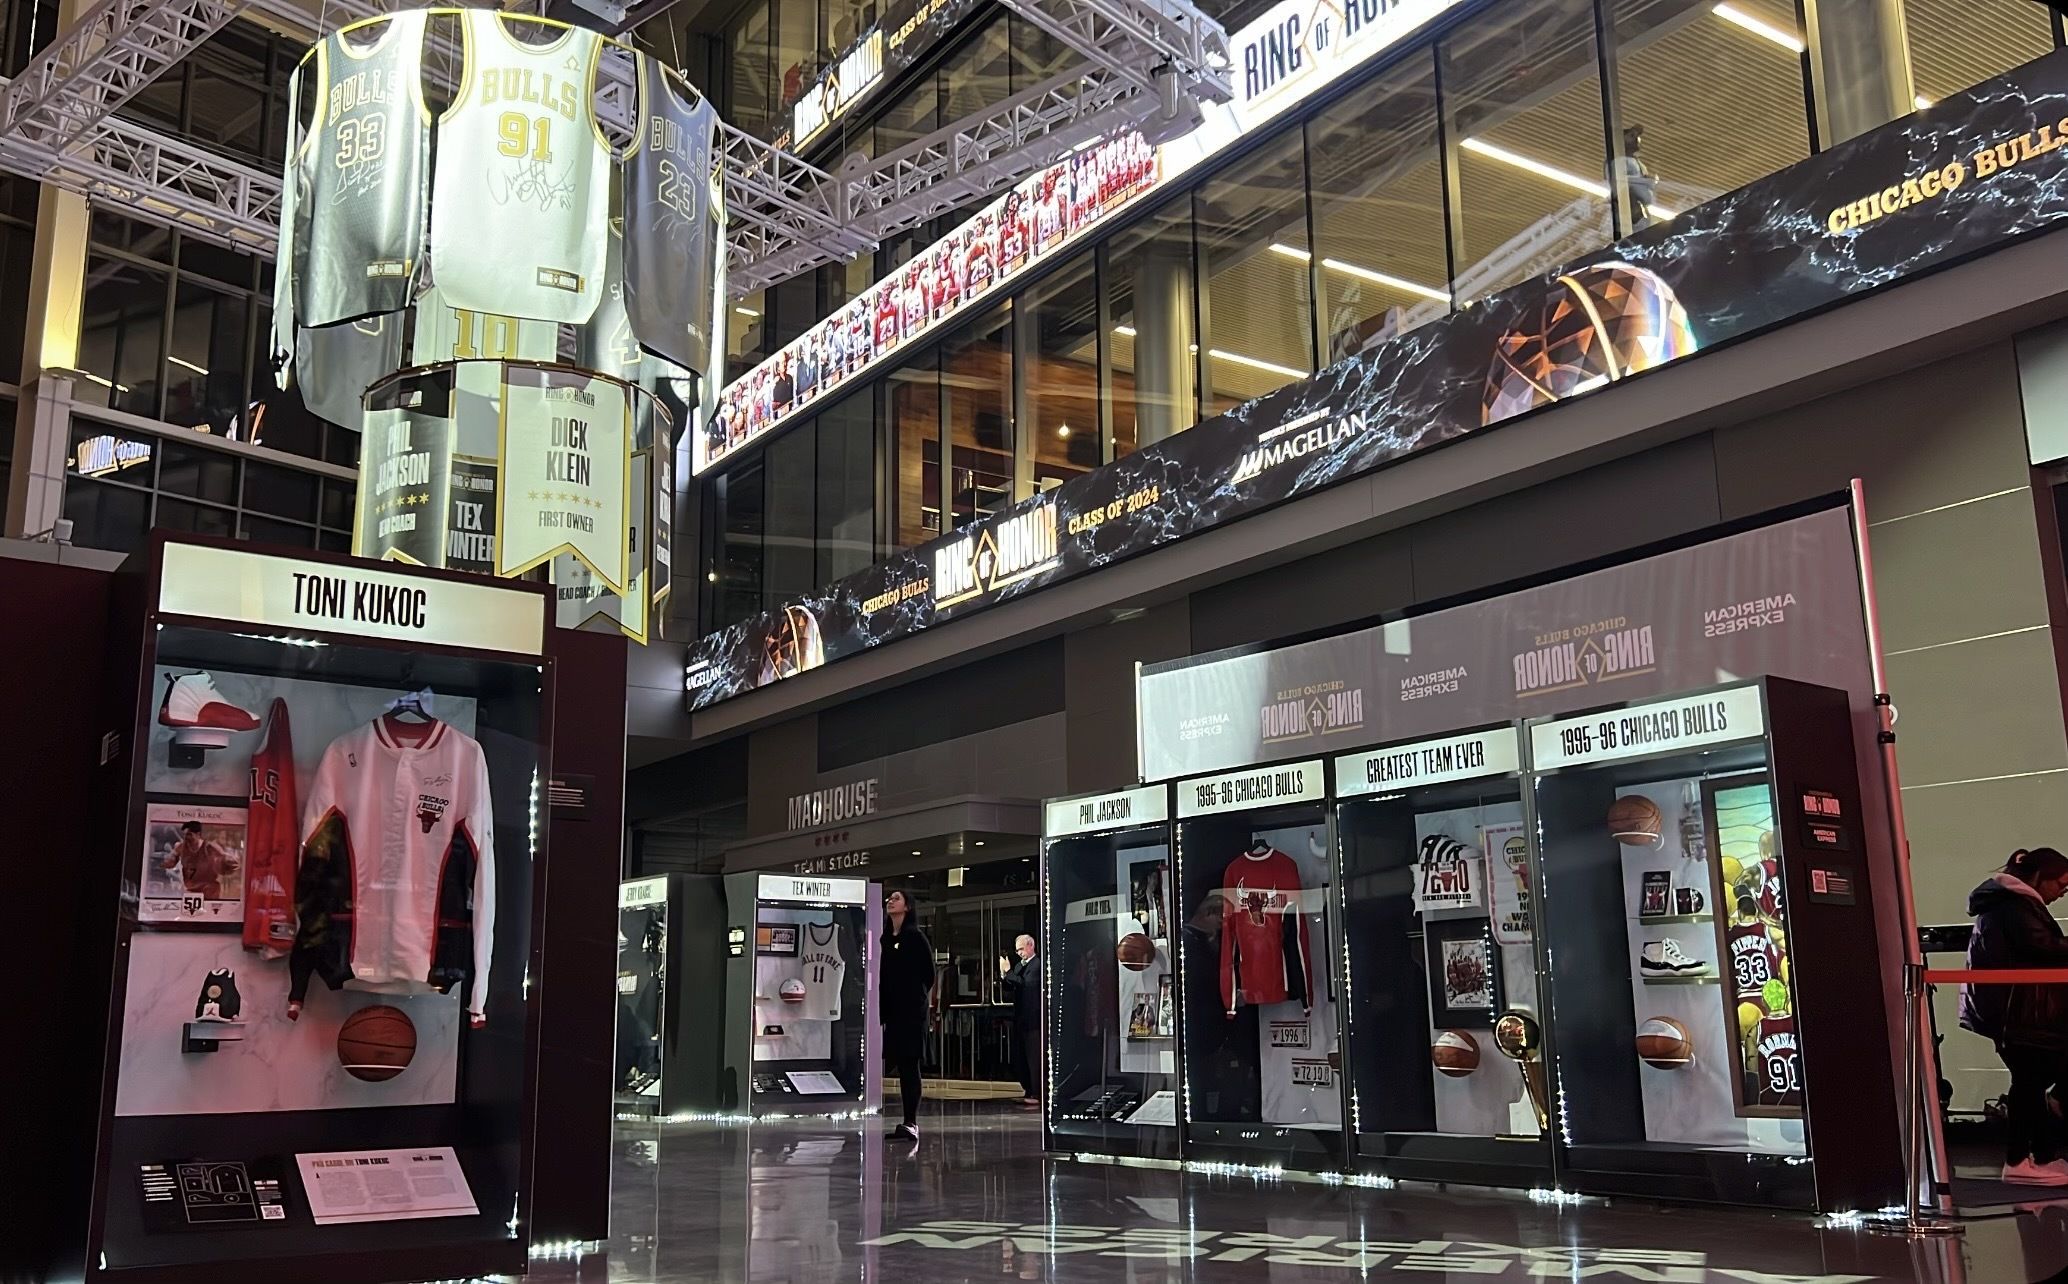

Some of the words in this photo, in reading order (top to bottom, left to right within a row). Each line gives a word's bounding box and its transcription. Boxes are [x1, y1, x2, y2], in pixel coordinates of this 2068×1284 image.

[889, 16, 916, 50] CLASS
[916, 4, 929, 25] OF
[1245, 13, 1302, 101] RING
[1316, 16, 1329, 51] OF
[329, 69, 400, 127] BULLS
[480, 67, 577, 122] BULLS
[336, 111, 386, 168] 33
[497, 111, 552, 163] 91
[651, 115, 706, 187] BULLS
[658, 159, 696, 221] 23
[1828, 161, 1966, 235] CHICAGO
[1974, 117, 2068, 179] BULLS
[1005, 232, 1023, 259] 53
[453, 308, 520, 360] 10
[880, 321, 895, 341] 23
[387, 420, 412, 456] PHIL
[551, 416, 588, 452] DICK
[1264, 410, 1368, 469] MAGELLAN
[376, 452, 431, 496] JACKSON
[546, 451, 591, 487] KLEIN
[455, 500, 484, 531] TEX
[539, 511, 565, 528] FIRST
[566, 512, 594, 534] OWNER
[1068, 506, 1105, 535] CLASS
[1107, 499, 1123, 520] OF
[1127, 485, 1159, 513] 2024
[936, 537, 974, 600] RING
[979, 550, 991, 580] OF
[997, 503, 1058, 576] HONOR
[293, 573, 346, 619] TONI
[353, 581, 427, 629] KUKOC
[558, 587, 574, 600] HEAD
[575, 585, 595, 600] COACH
[861, 589, 900, 616] CHICAGO
[901, 577, 929, 600] BULLS
[1560, 721, 1617, 758] 1995-96
[1620, 710, 1680, 749] CHICAGO
[1684, 701, 1728, 737] BULLS
[1366, 751, 1419, 784] GREATEST
[1421, 746, 1452, 776] TEAM
[1455, 740, 1485, 770] EVER
[418, 794, 450, 806] CHICAGO
[788, 779, 877, 831] MADHOUSE
[1196, 783, 1233, 808] 1995-96
[1235, 776, 1273, 803] CHICAGO
[1276, 770, 1304, 796] BULLS
[1080, 803, 1095, 825] PHIL
[1097, 797, 1132, 822] JACKSON
[794, 858, 826, 874] TEAM
[830, 852, 871, 871] STORE
[184, 897, 202, 909] 50
[792, 881, 804, 896] TEX
[806, 881, 831, 897] WINTER
[812, 966, 825, 983] 11
[1734, 953, 1771, 987] 33
[1281, 1028, 1299, 1042] 1996
[1302, 1066, 1311, 1080] 72
[1313, 1066, 1323, 1080] 10
